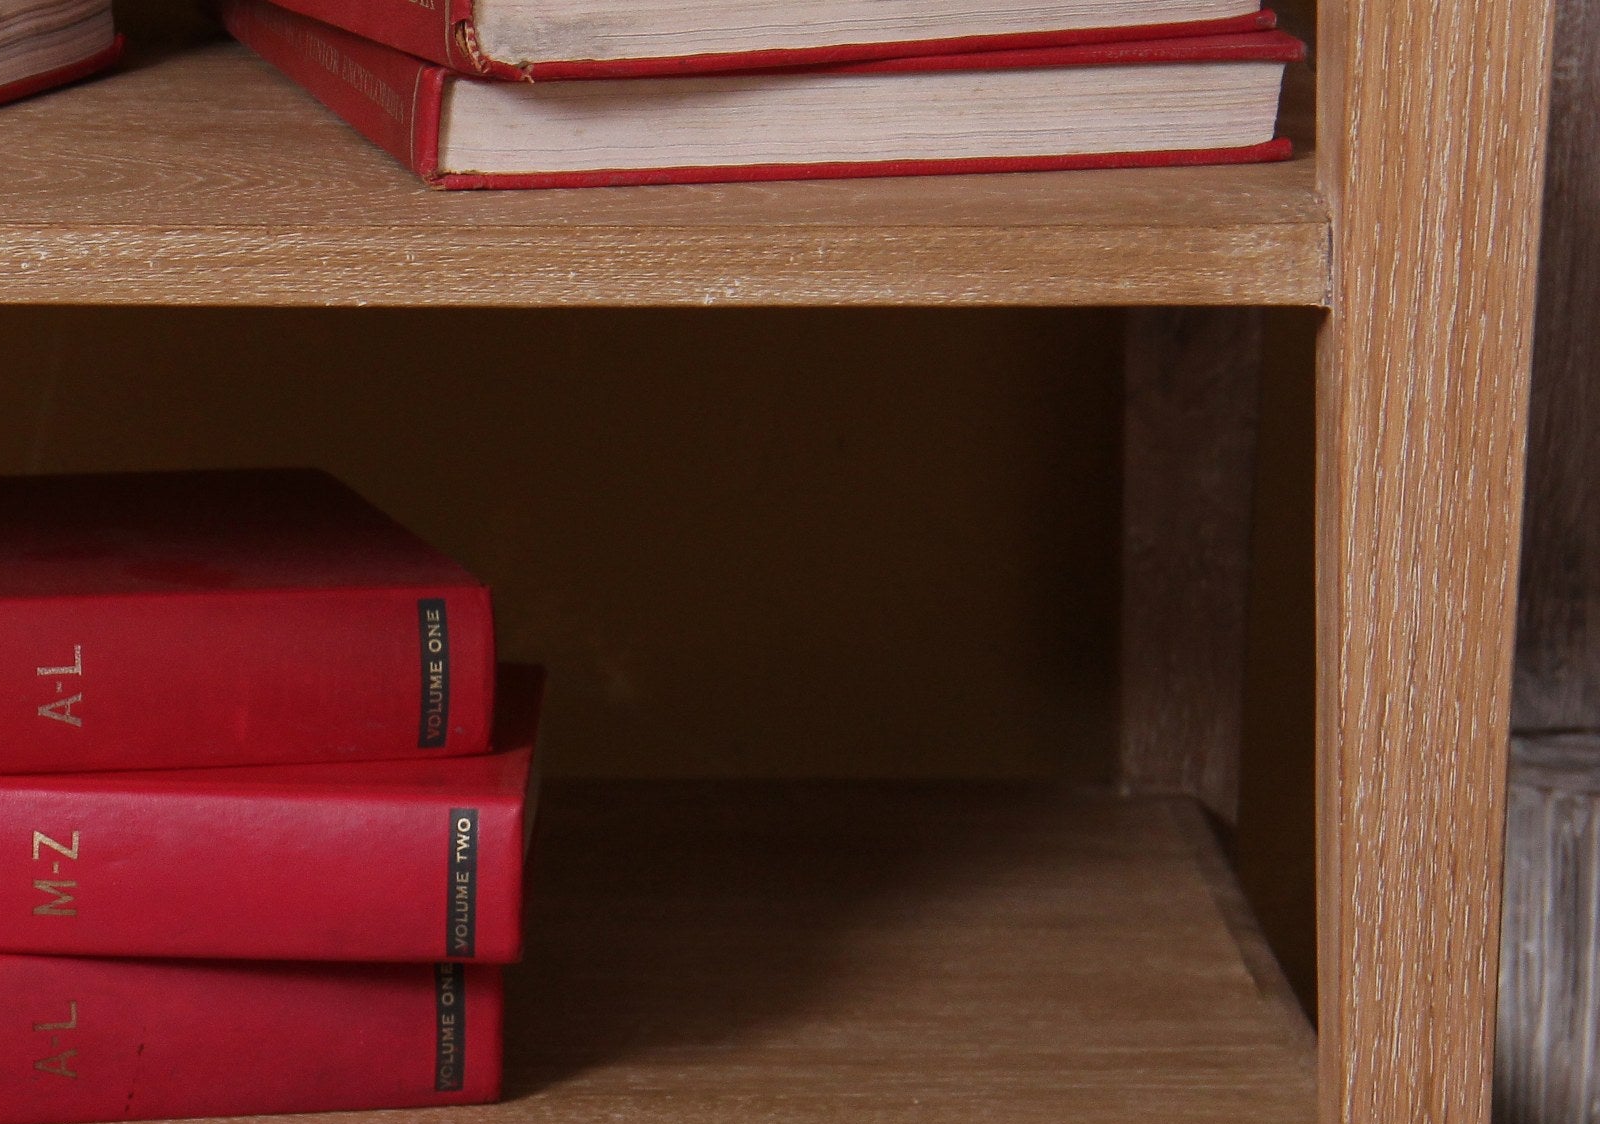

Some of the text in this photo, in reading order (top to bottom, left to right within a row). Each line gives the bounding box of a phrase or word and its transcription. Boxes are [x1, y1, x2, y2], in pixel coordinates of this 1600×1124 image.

[36, 643, 82, 727] A-L
[426, 609, 443, 739] VOLUME ONE
[33, 830, 80, 917] M-Z
[455, 817, 471, 949] VOLUME TWO
[32, 1000, 78, 1079] A-L
[440, 1013, 455, 1089] VOLUME
